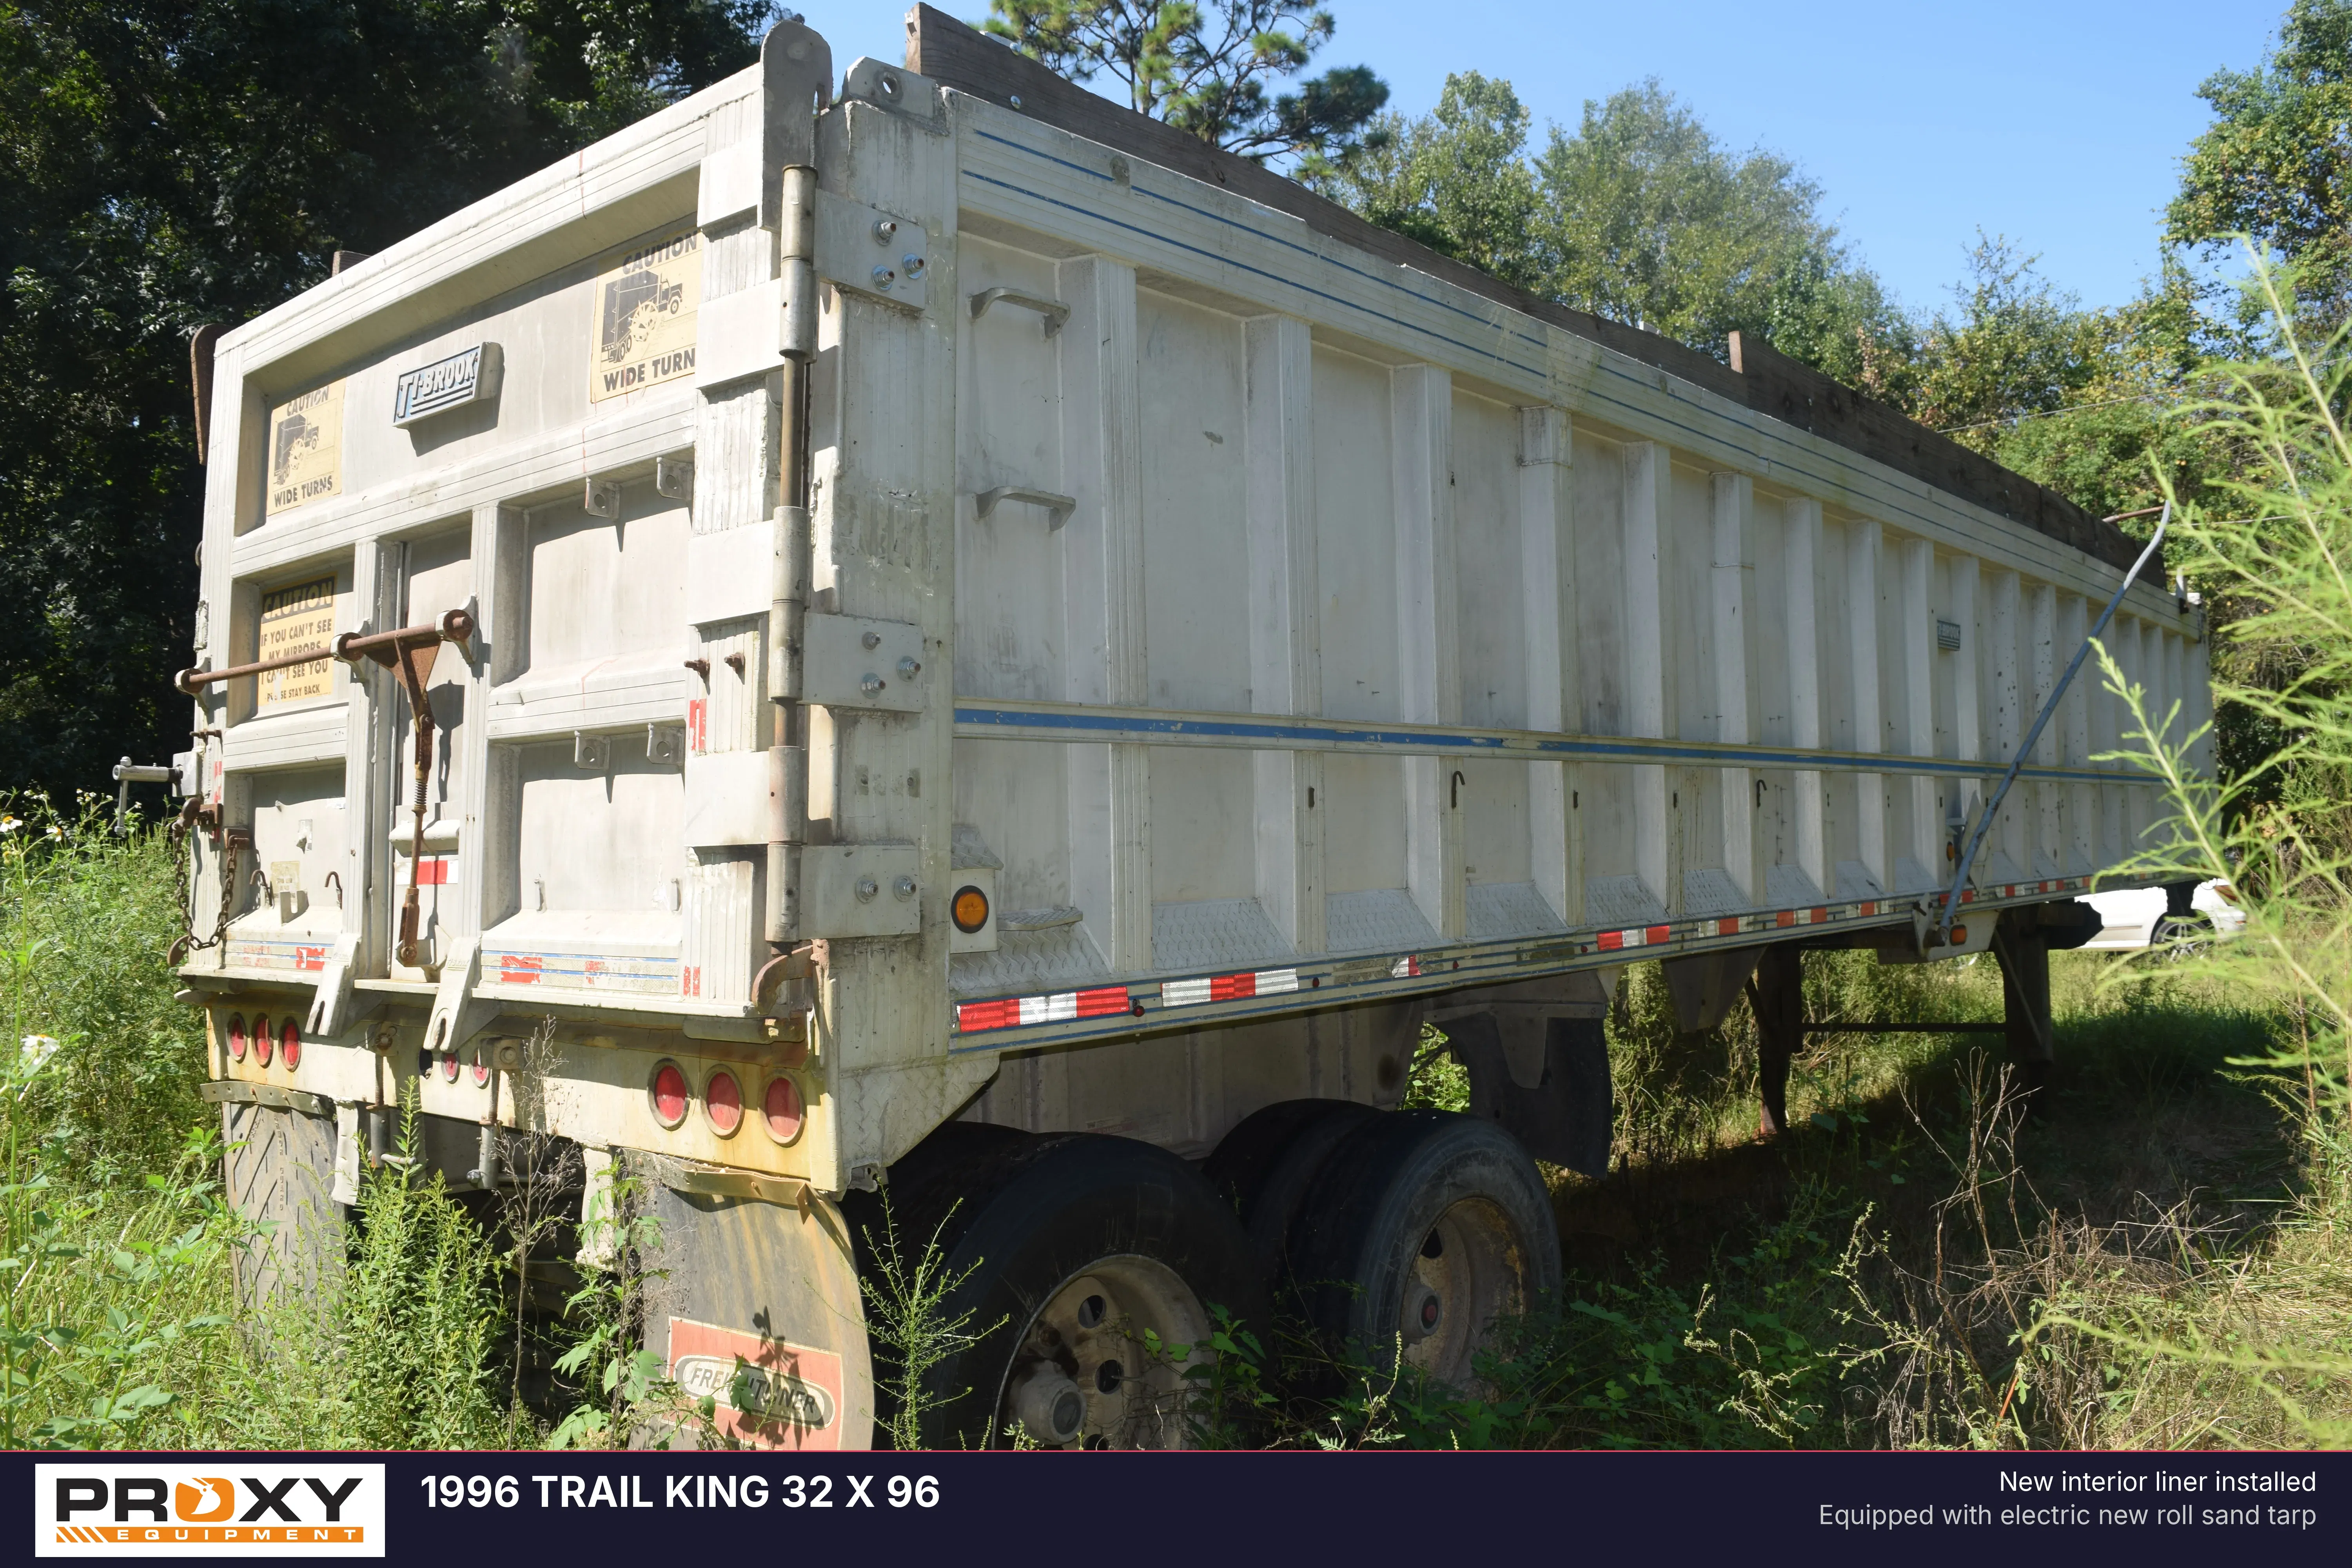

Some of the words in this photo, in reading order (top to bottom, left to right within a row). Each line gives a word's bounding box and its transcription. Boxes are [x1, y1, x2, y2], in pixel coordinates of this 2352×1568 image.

[622, 230, 698, 275] CAUTION
[397, 351, 477, 418] TI-BROOK
[604, 363, 645, 392] WIDE
[652, 348, 695, 378] TURN
[274, 487, 297, 507] WIDE
[301, 475, 332, 499] TURNS
[264, 581, 332, 620] CAUTION
[260, 633, 267, 646] IF
[270, 629, 286, 644] YOU
[289, 622, 313, 640] CAN'T
[316, 618, 332, 633] SEE
[269, 649, 281, 661] MY
[293, 663, 305, 679] SEE
[309, 659, 328, 675] YOU
[289, 687, 302, 698] STAY
[304, 684, 320, 695] BACK
